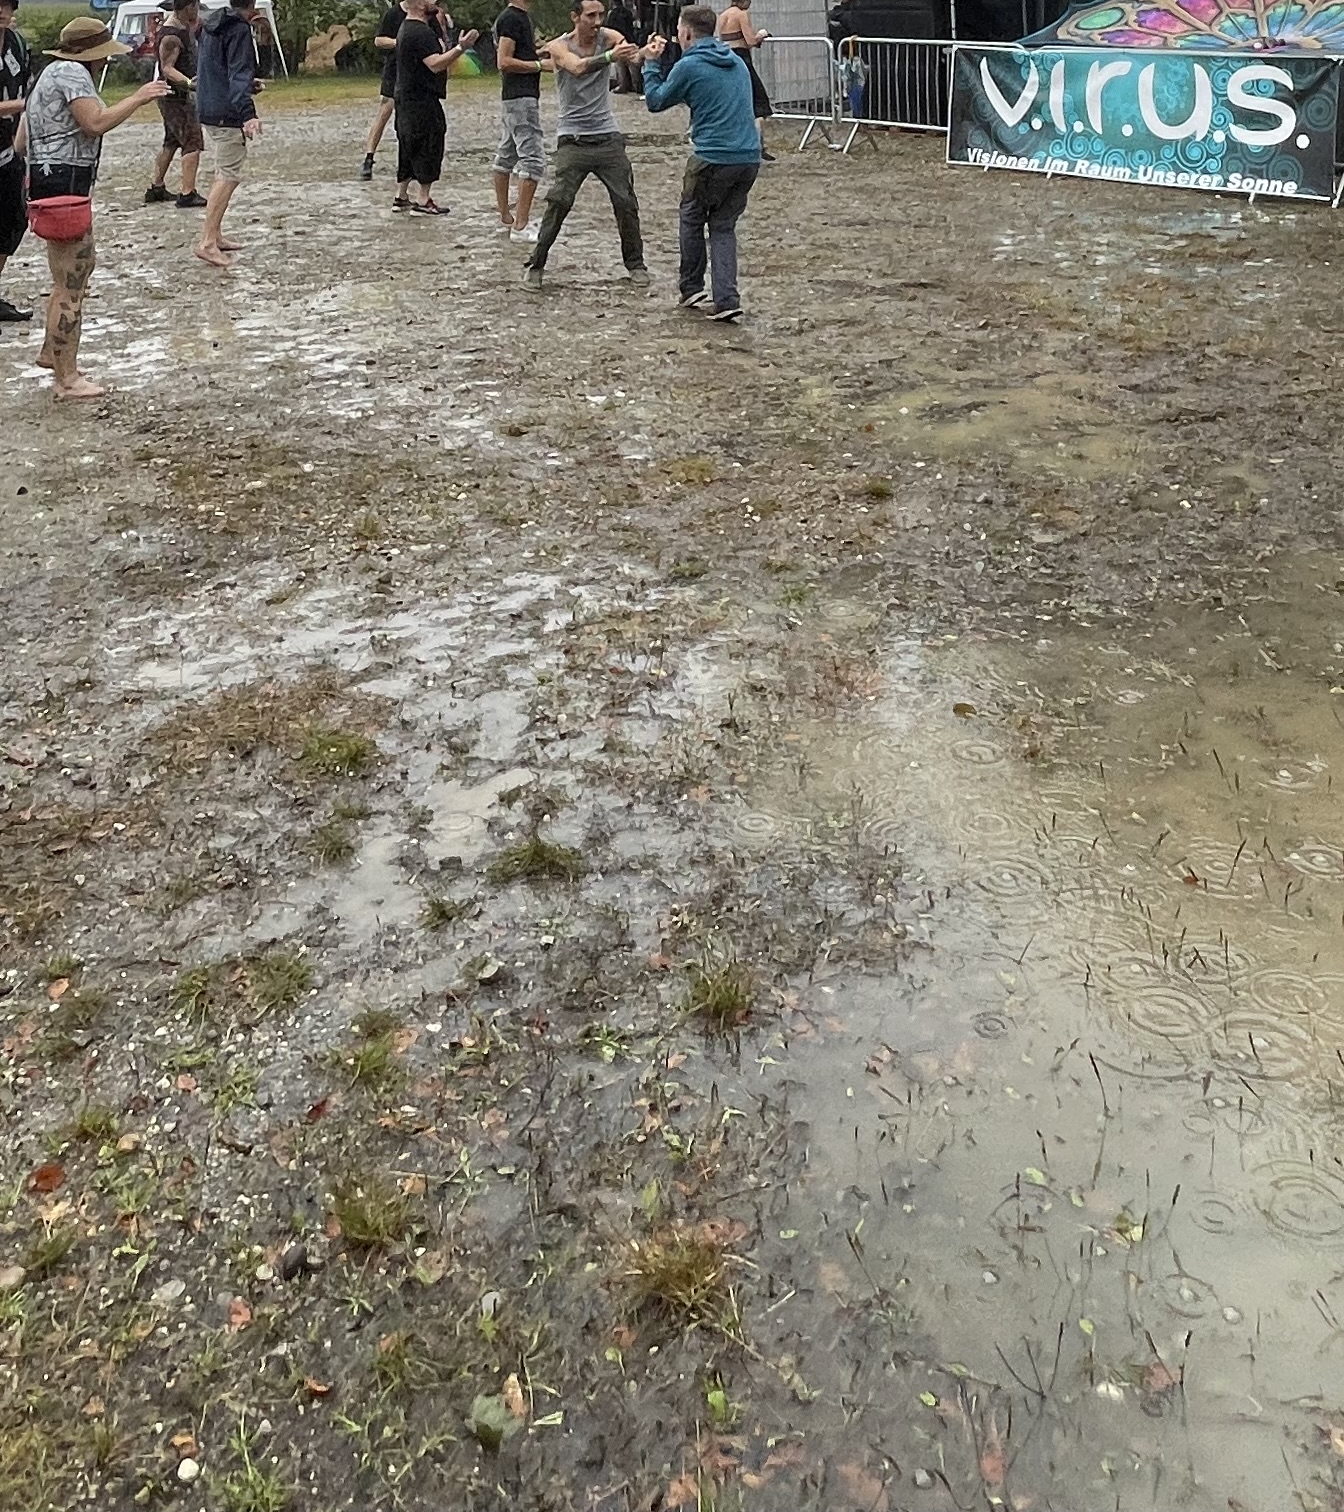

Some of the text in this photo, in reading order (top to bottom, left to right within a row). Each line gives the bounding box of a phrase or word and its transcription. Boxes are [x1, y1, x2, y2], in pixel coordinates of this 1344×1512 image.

[967, 147, 1041, 171] Visionen
[1074, 159, 1132, 181] Raum
[1138, 165, 1223, 187] Unserer
[1227, 172, 1299, 194] Sonne
